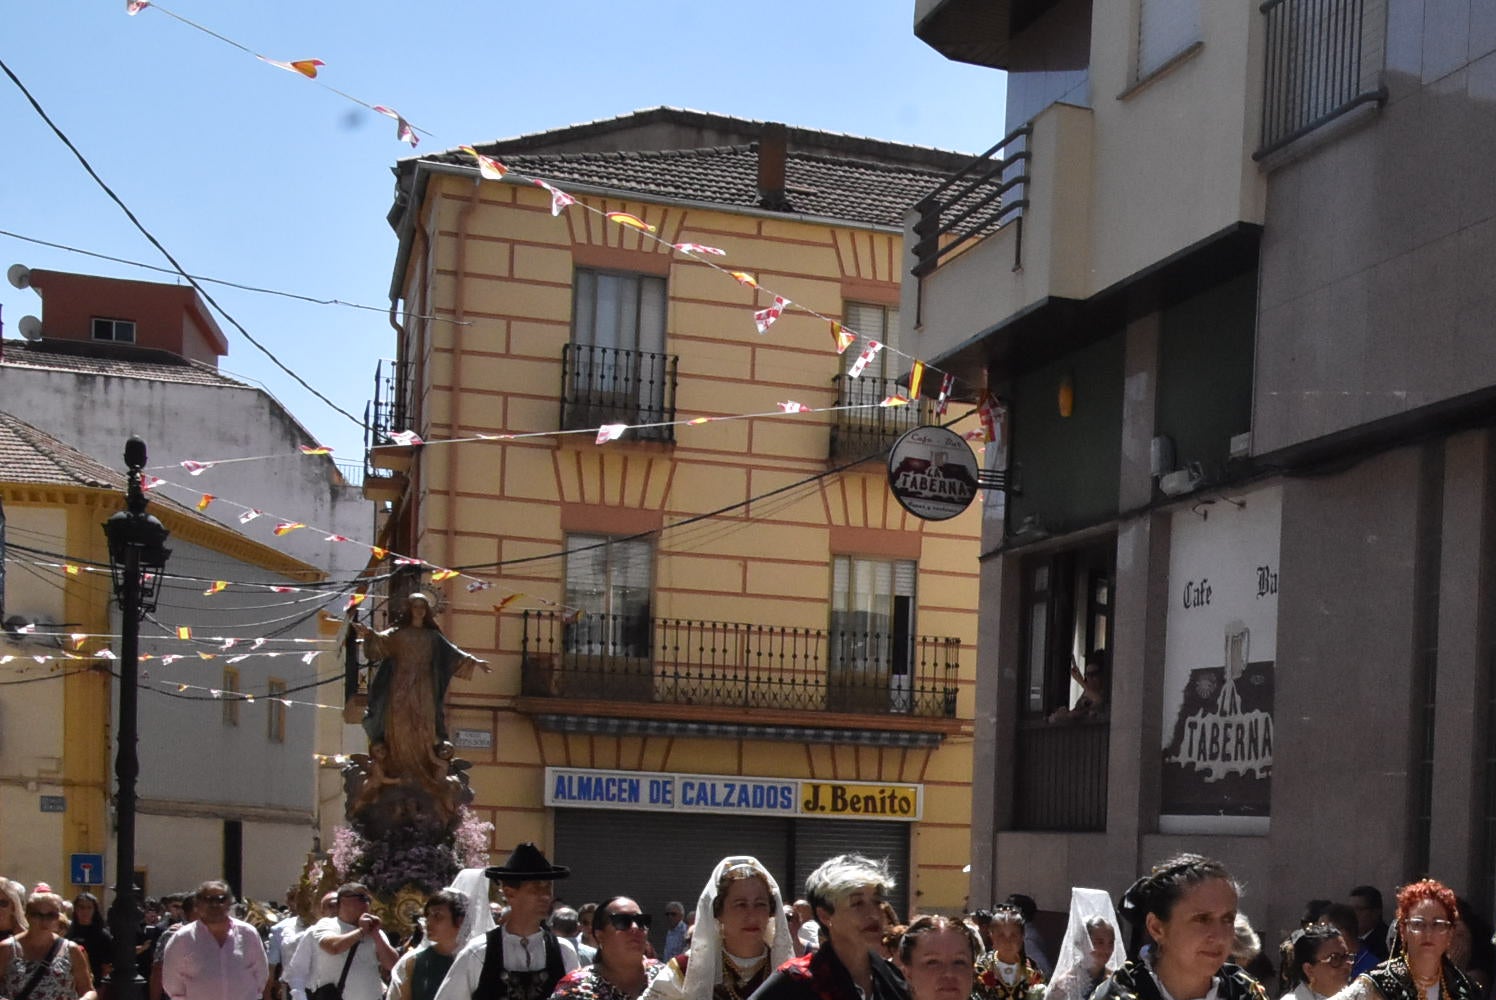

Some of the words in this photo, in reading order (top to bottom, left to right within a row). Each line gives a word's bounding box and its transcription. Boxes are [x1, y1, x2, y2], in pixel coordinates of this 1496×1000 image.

[901, 473, 968, 496] TABERNA
[927, 466, 942, 478] LA
[1183, 578, 1212, 609] Cafe
[1256, 565, 1278, 600] Ba
[1218, 688, 1239, 717] LA
[1187, 716, 1273, 763] TABERNA
[554, 775, 640, 804] ALMACEN
[649, 779, 673, 806] DE
[681, 781, 793, 810] CALZADOS
[830, 785, 911, 815] Benito
